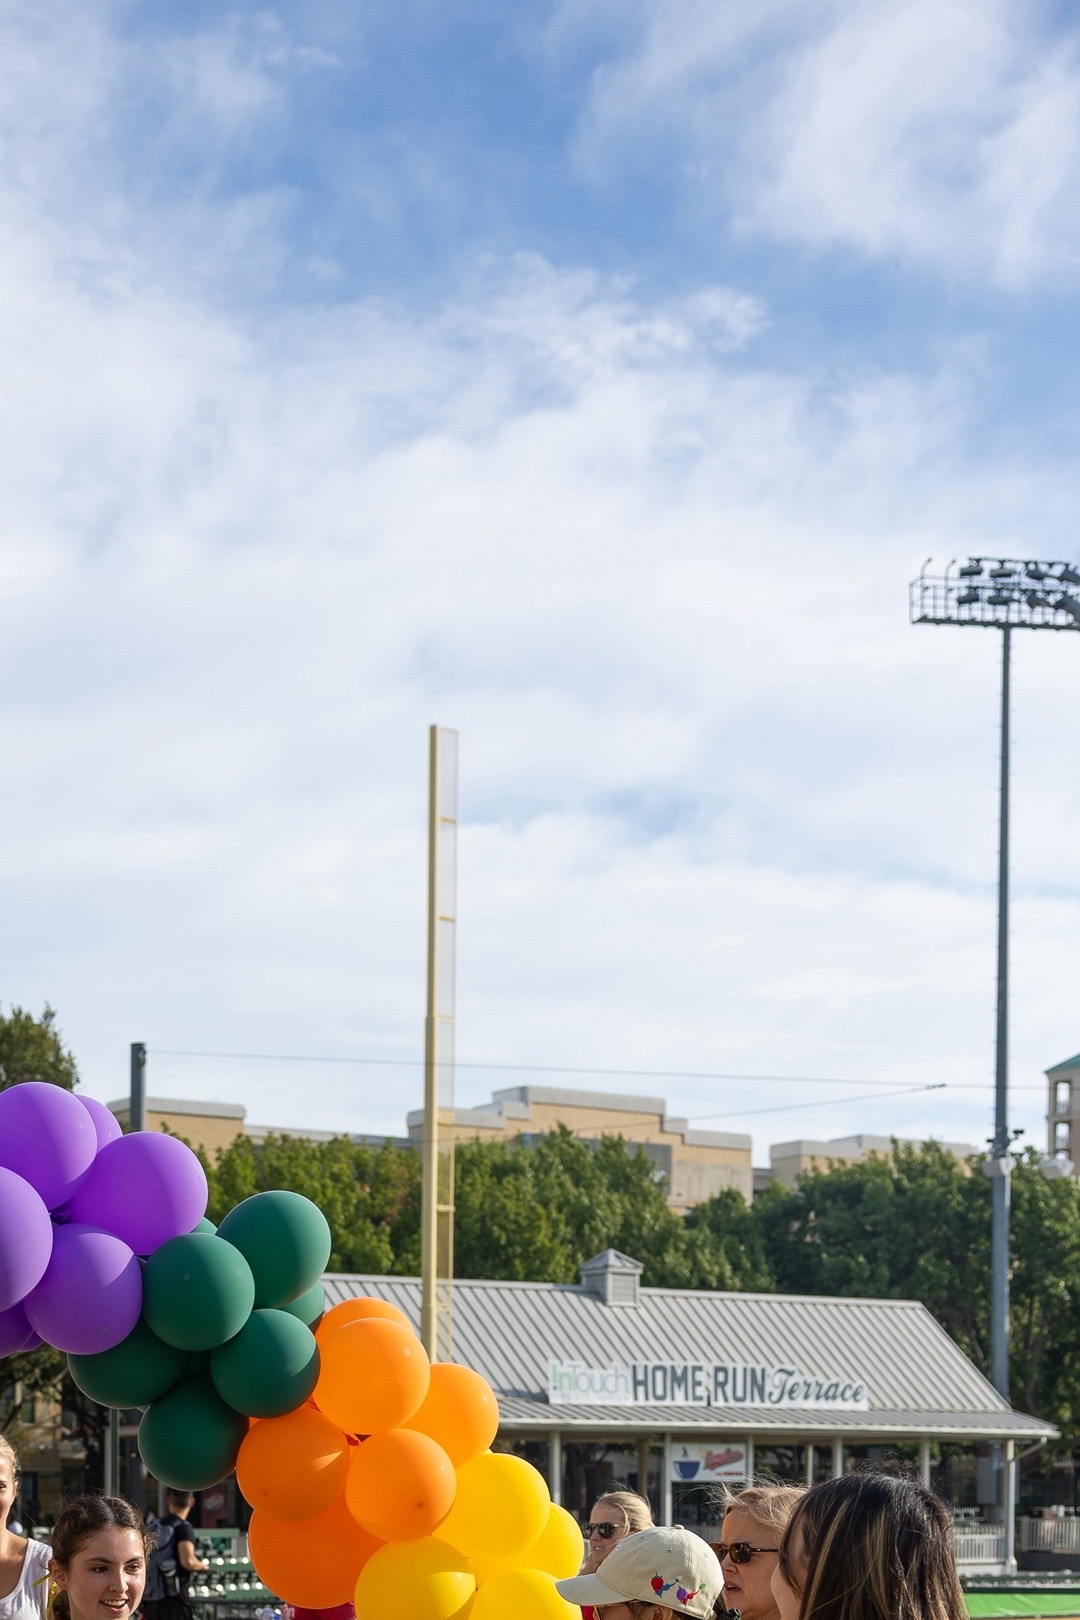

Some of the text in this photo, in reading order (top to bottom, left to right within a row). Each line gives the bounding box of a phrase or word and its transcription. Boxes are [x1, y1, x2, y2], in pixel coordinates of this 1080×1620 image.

[632, 1365, 704, 1402] HOME
[713, 1366, 766, 1403] RUN
[770, 1367, 865, 1404] Terrace
